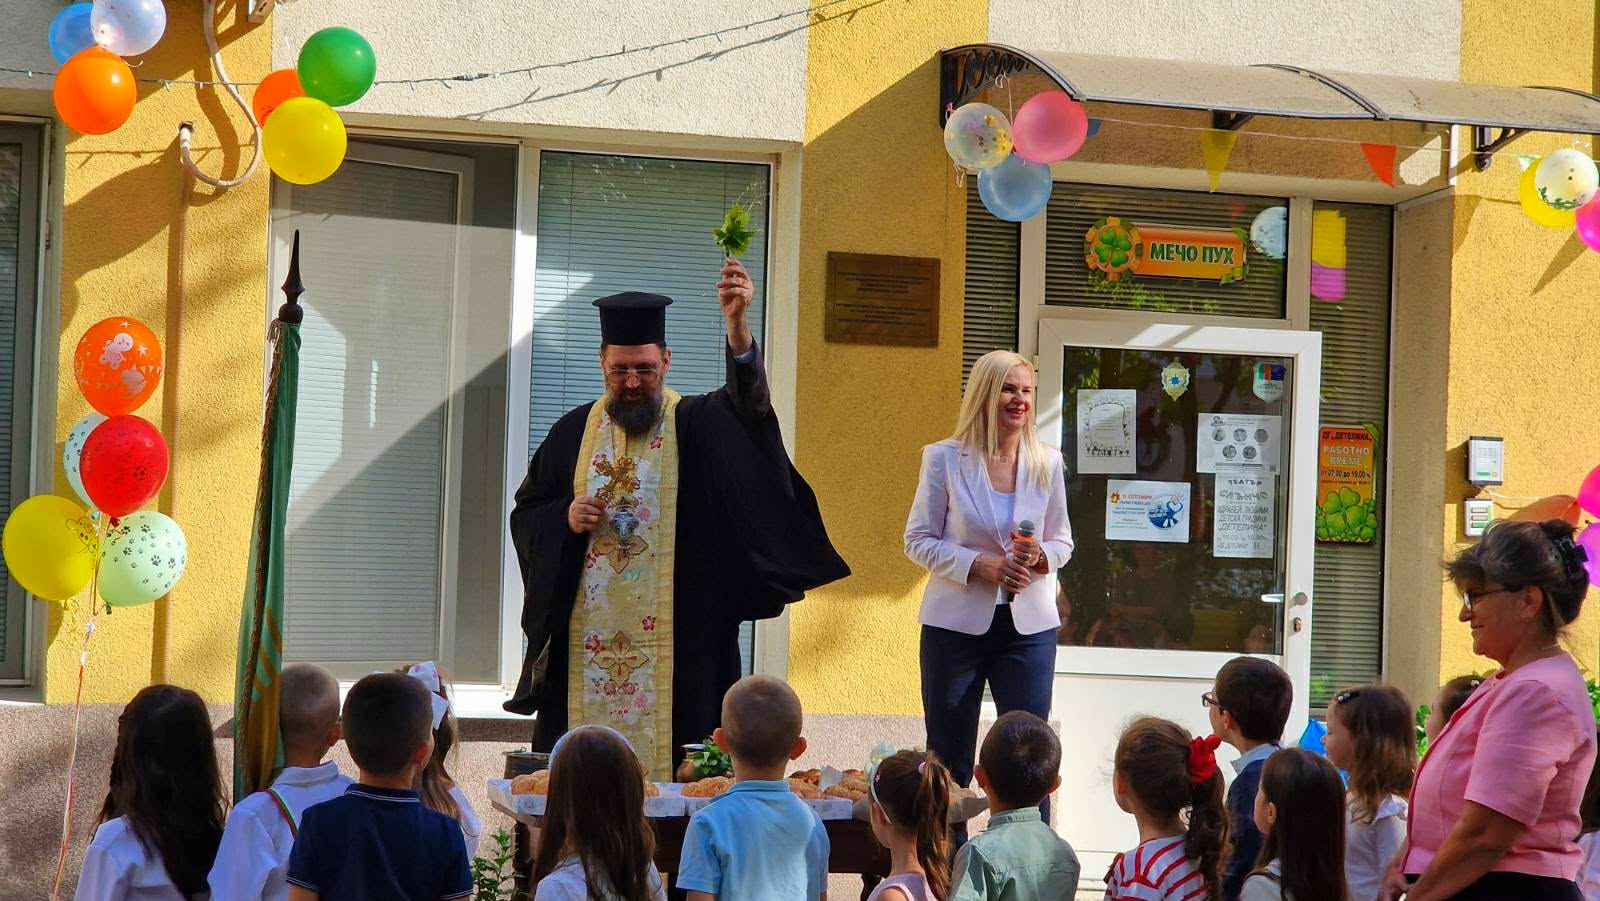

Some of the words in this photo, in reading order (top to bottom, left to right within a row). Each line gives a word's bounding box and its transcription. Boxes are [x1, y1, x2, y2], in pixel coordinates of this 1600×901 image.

[1150, 242, 1198, 262] МЕЧО
[1202, 246, 1234, 265] ПУХ
[1323, 445, 1370, 456] РАБОТНО
[1330, 456, 1363, 466] ВРЕМЕ
[1218, 490, 1268, 501] СЛЪНЧО
